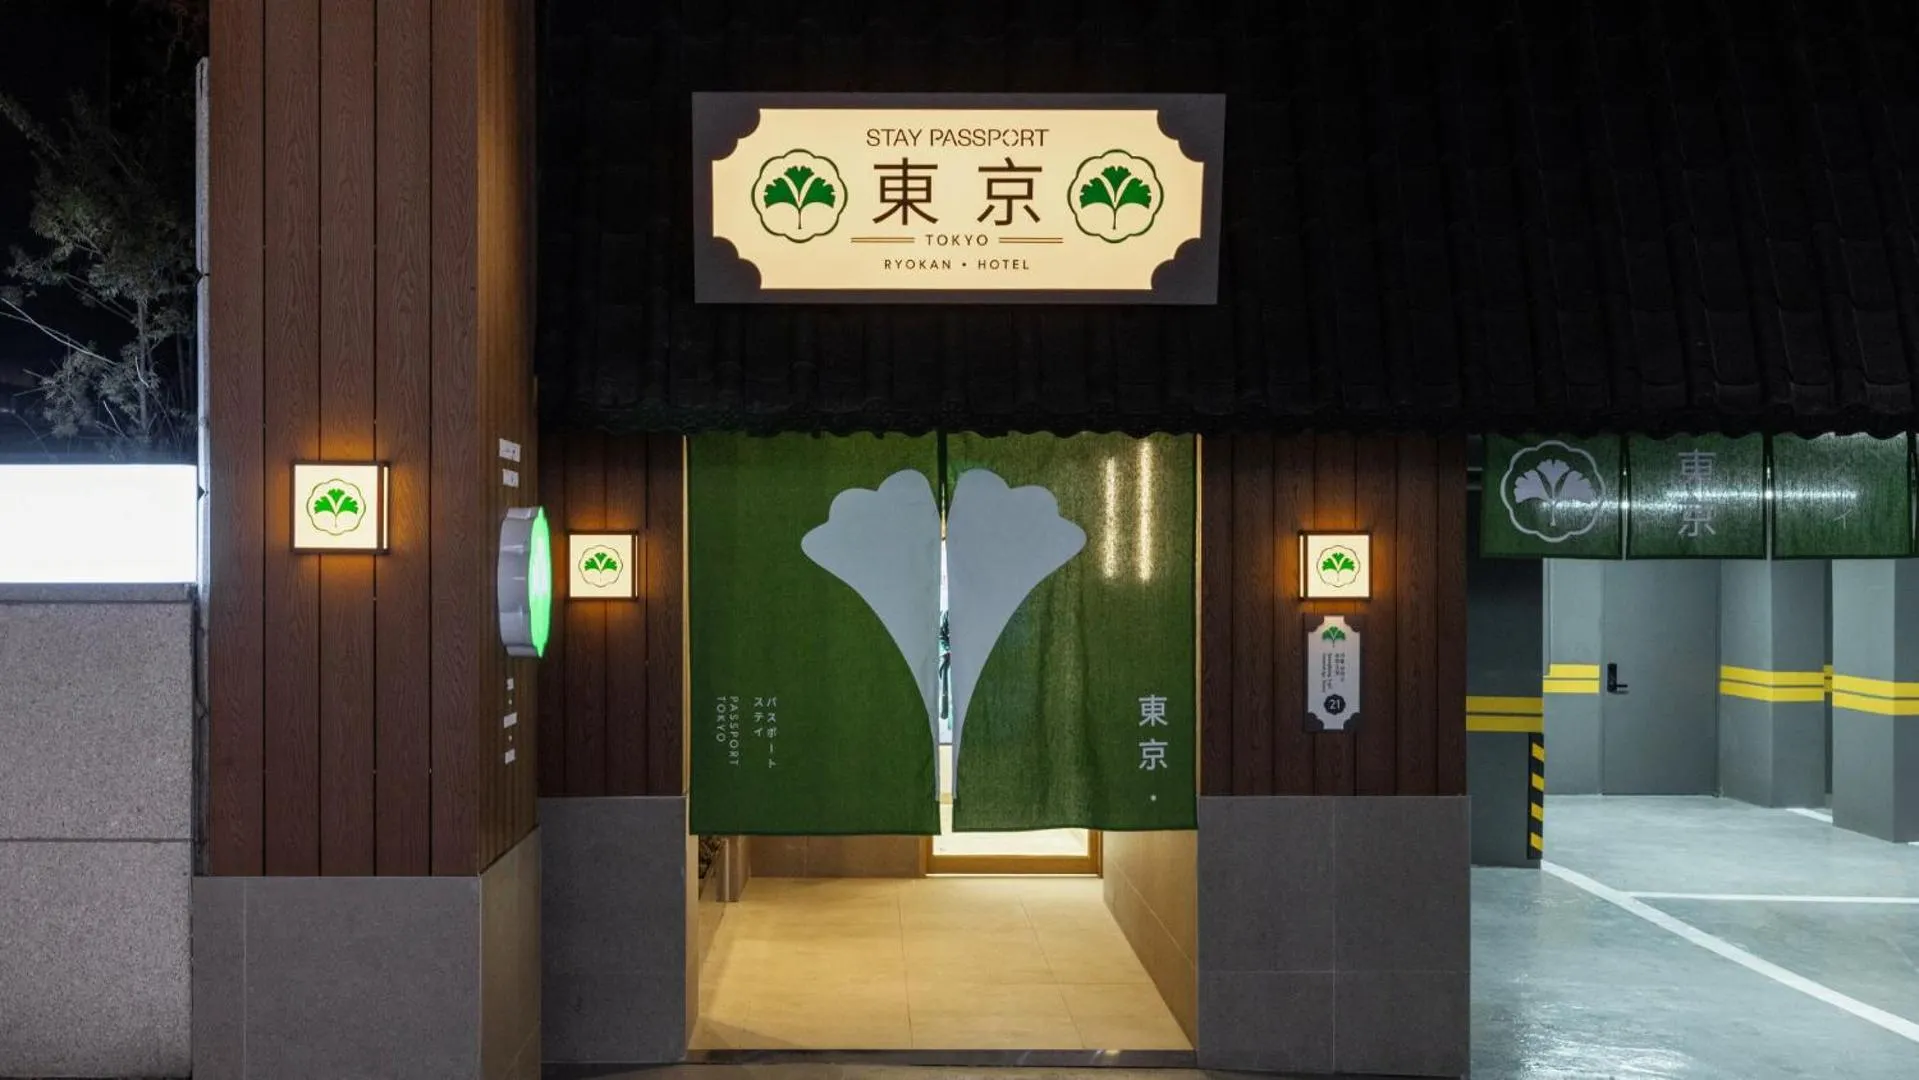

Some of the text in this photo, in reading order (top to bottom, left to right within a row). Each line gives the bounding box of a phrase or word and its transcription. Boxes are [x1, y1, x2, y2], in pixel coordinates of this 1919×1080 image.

[867, 129, 1050, 147] STAY PASSPORT
[872, 157, 1043, 226] 東京
[884, 259, 1030, 270] RYOKAN HOTEL
[925, 234, 989, 247] TOKYO
[716, 695, 727, 743] TOKYO
[728, 695, 740, 766] PASSPORT
[1138, 694, 1169, 771] 東京
